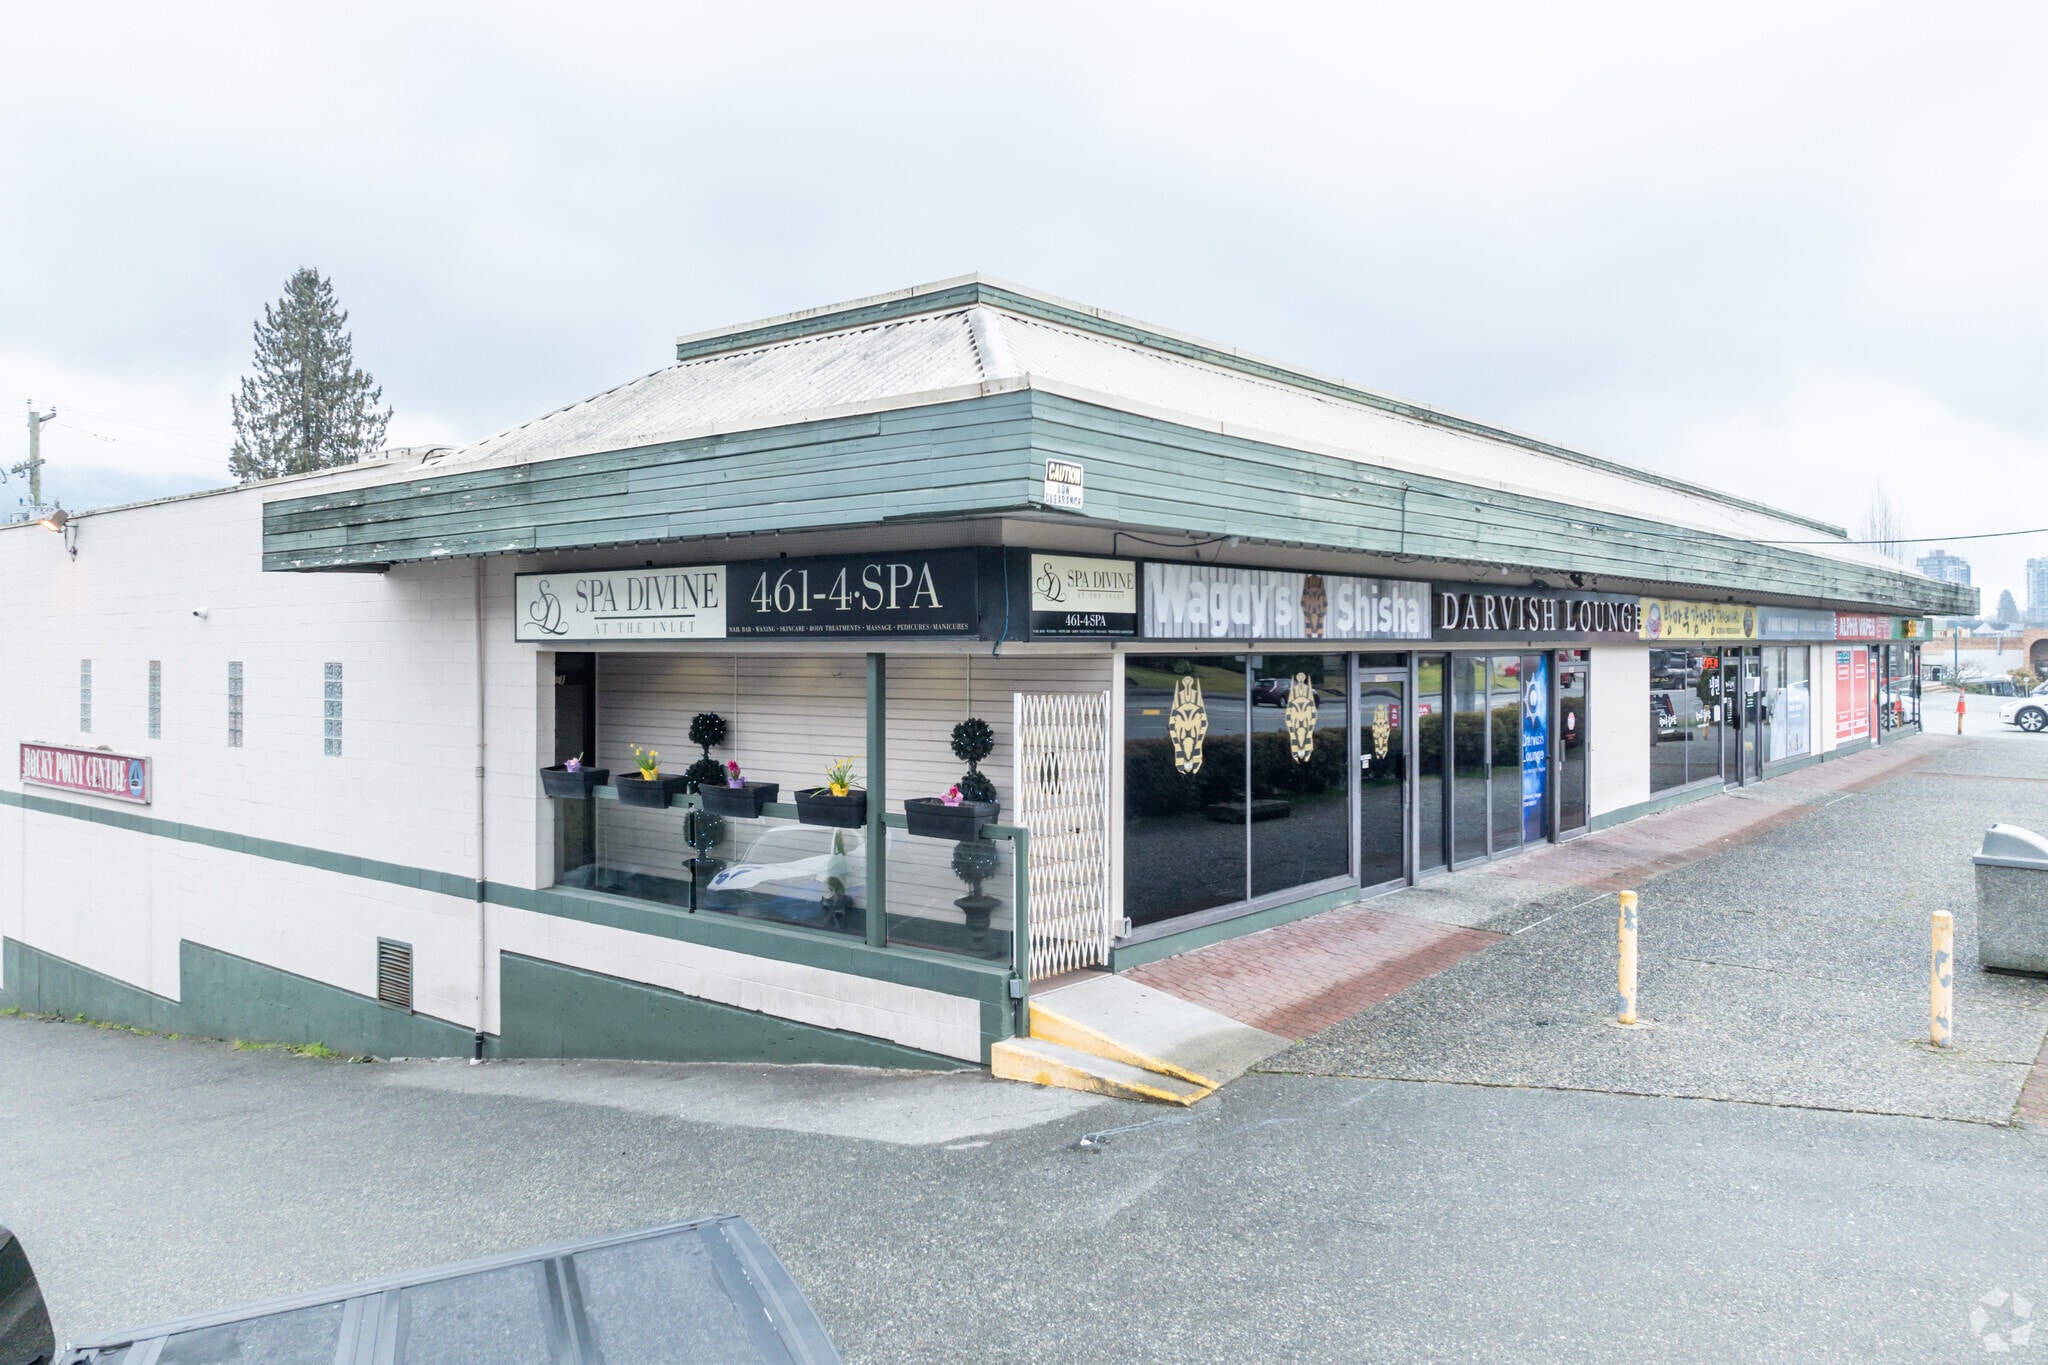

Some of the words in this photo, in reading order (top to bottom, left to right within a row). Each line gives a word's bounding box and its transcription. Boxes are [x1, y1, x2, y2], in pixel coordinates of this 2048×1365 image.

[1048, 463, 1081, 484] CAUTION
[1057, 484, 1070, 495] LOW
[1067, 569, 1090, 588] SPA
[1093, 571, 1134, 590] DIVINE
[575, 578, 619, 614] SPA
[626, 572, 719, 612] DIVINE
[1151, 565, 1293, 638] Wagdy's
[1337, 583, 1420, 633] Shisha
[1441, 592, 1557, 632] DARVISH
[1565, 600, 1643, 633] LOUNGE
[594, 622, 608, 635] AT
[618, 621, 643, 634] THE
[652, 620, 696, 634] INLET
[824, 624, 862, 632] TREATMENTS
[1839, 616, 1858, 637] ALPHA
[1859, 617, 1876, 637] VAPES
[1522, 750, 1545, 765] ounge
[23, 748, 55, 780] ROCKY
[55, 752, 85, 785] POINT
[85, 756, 127, 792] CENTRE
